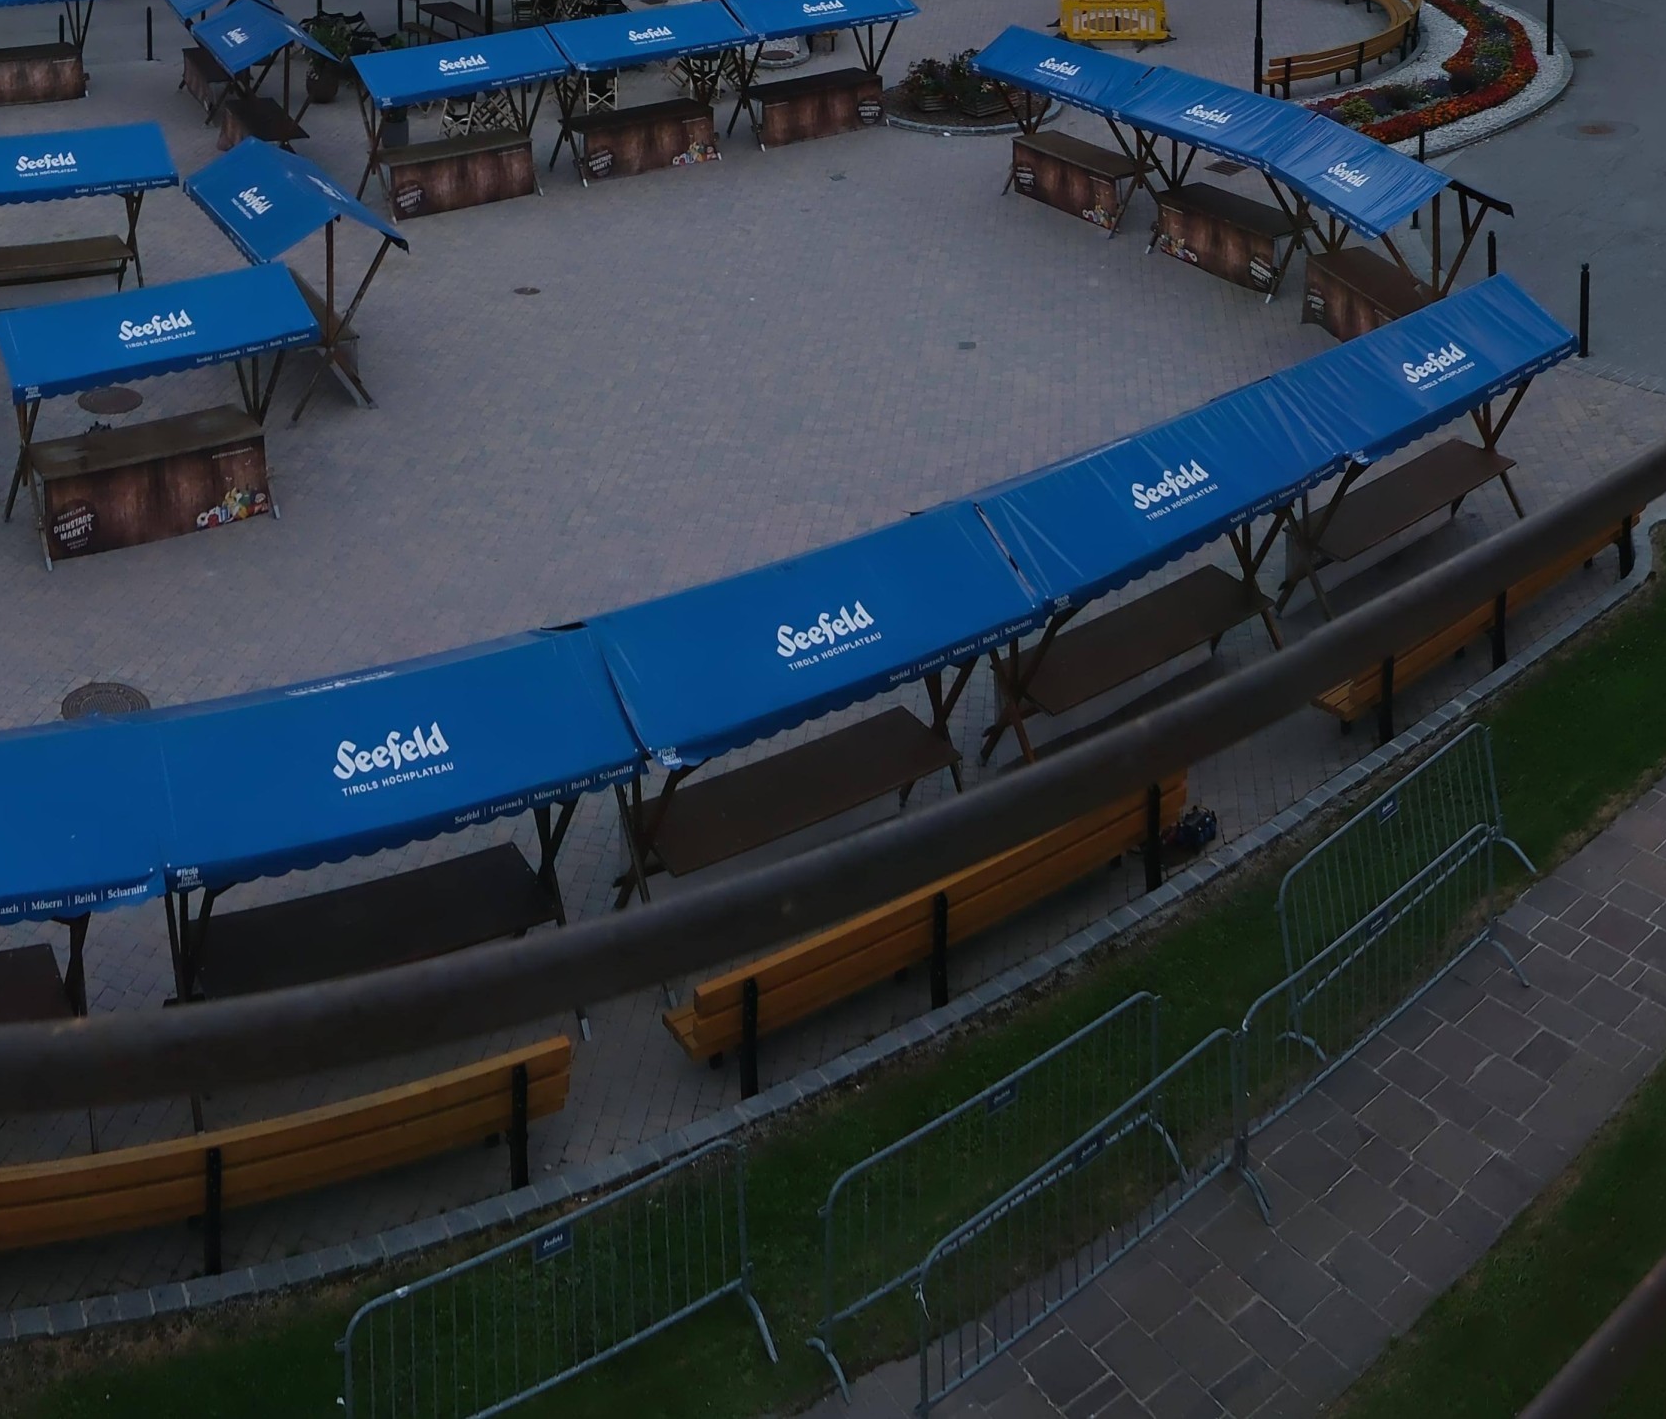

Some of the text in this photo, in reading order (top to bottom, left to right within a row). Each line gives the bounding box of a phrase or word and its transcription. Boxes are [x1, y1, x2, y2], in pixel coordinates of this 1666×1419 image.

[802, 0, 845, 14] Seefeld
[628, 25, 673, 41] Seefeld
[438, 54, 487, 71] Seefeld
[1039, 57, 1082, 77] Seefeld
[1185, 104, 1233, 124] Seefeld
[15, 151, 77, 171] Seefeld
[1327, 162, 1370, 188] Seefeld
[118, 309, 193, 341] Seefeld
[124, 330, 196, 349] TIROLS HOCHPLATEAU
[1402, 342, 1467, 384] Seefeld
[1131, 459, 1210, 511] Seefeld
[1145, 483, 1219, 522] TIROLS HOCHPLATEAU
[776, 599, 874, 658] Seefeld
[787, 631, 883, 672] TIROLS HOCHPLATEAU
[333, 721, 450, 780] Seefeld
[341, 761, 455, 797] TIROLS HOCHPLATEAU
[454, 809, 480, 824] Seefeld
[490, 797, 523, 814] Leutasch
[31, 897, 63, 911] Mösern
[74, 892, 97, 905] Reith
[107, 884, 148, 899] Scharnitz
